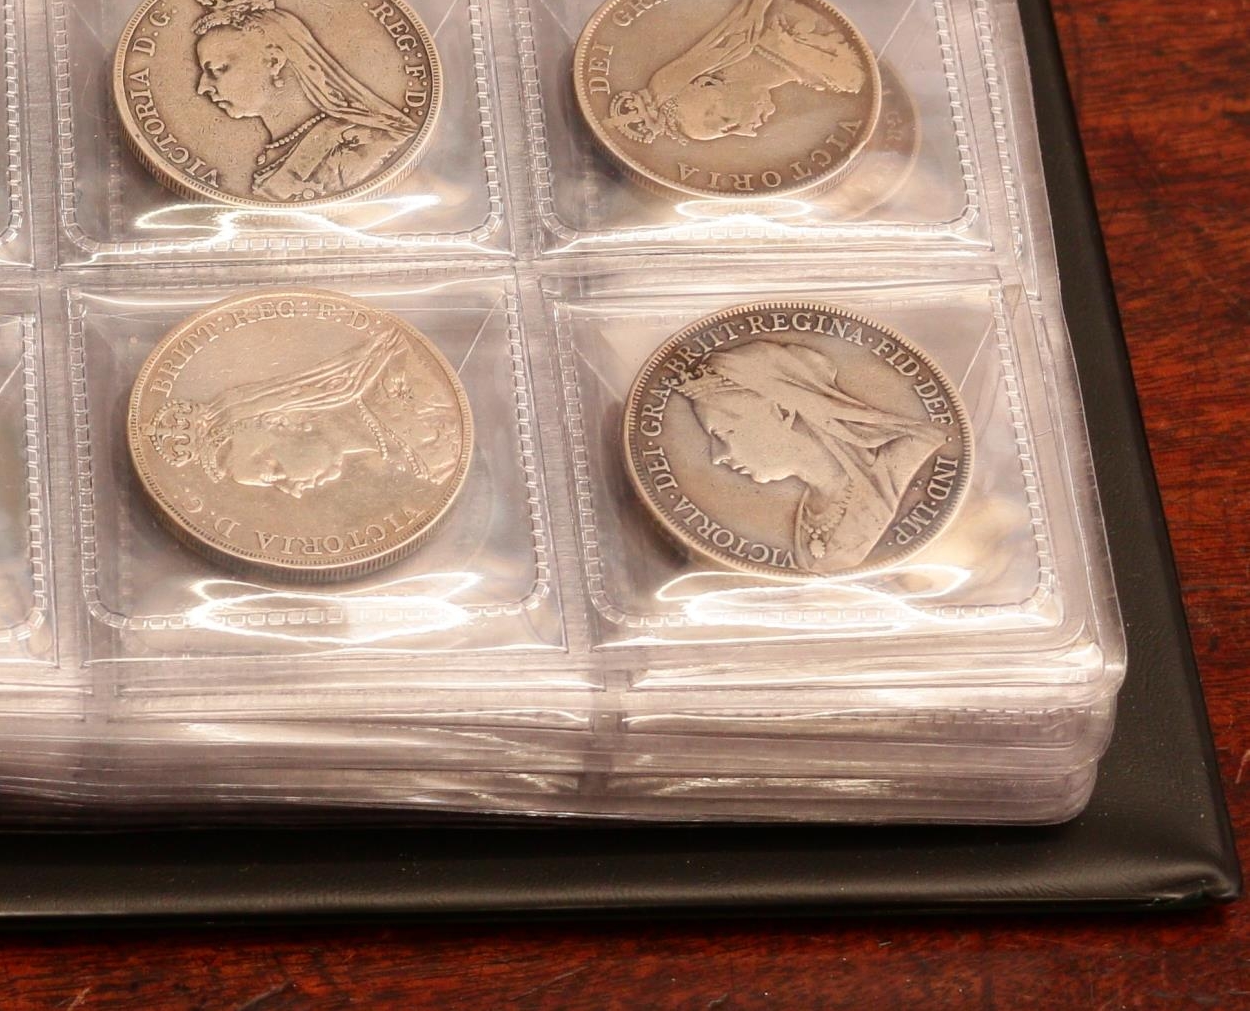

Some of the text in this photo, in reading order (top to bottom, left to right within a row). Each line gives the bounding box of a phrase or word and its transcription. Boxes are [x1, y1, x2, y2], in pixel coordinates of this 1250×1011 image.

[588, 44, 614, 96] DEI
[128, 66, 220, 189] VICTORIA
[677, 117, 864, 192] VICTORIA
[667, 320, 741, 377] BRITT
[749, 310, 866, 347] REGINA
[870, 337, 921, 379] FID
[913, 378, 954, 427] DEF
[642, 446, 679, 494] DEI
[925, 455, 959, 502] IND
[254, 508, 427, 556] VICTORIA
[671, 494, 800, 571] VICTORIA
[894, 500, 941, 547] IMP
